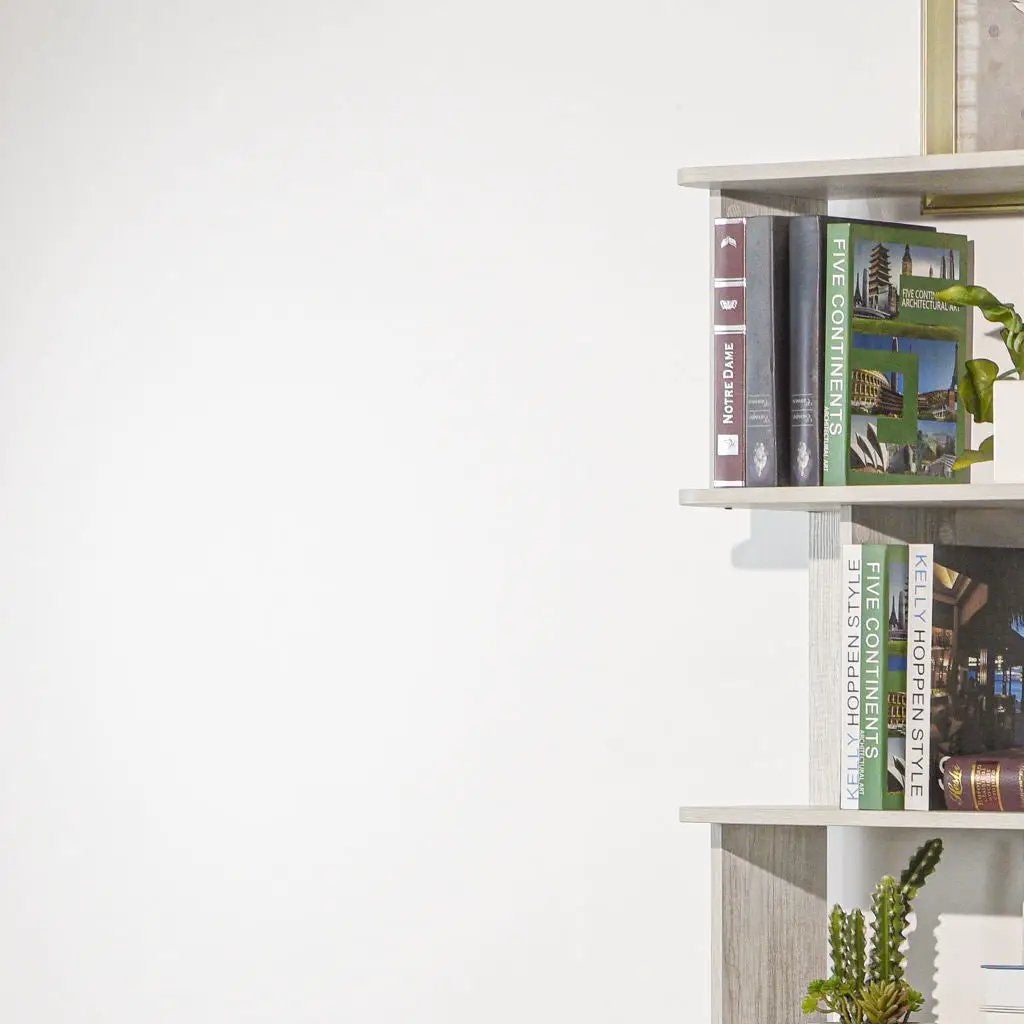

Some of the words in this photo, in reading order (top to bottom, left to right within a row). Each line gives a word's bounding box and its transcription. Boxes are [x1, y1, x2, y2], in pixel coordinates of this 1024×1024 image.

[832, 239, 846, 286] FIVE
[902, 288, 914, 298] FIVE
[902, 299, 948, 312] ARCHITECTURAL
[722, 342, 734, 378] DAME
[830, 294, 845, 435] CONTINENTS
[722, 382, 734, 424] NOTRE
[848, 559, 860, 628] STYLE
[866, 562, 880, 610] FIVE
[914, 554, 928, 623] KELLY
[848, 635, 860, 726] HOPPEN
[865, 618, 880, 759] CONTINENTS
[912, 630, 926, 721] HOPPEN
[847, 733, 858, 800] KELLY
[910, 728, 924, 797] STYLE
